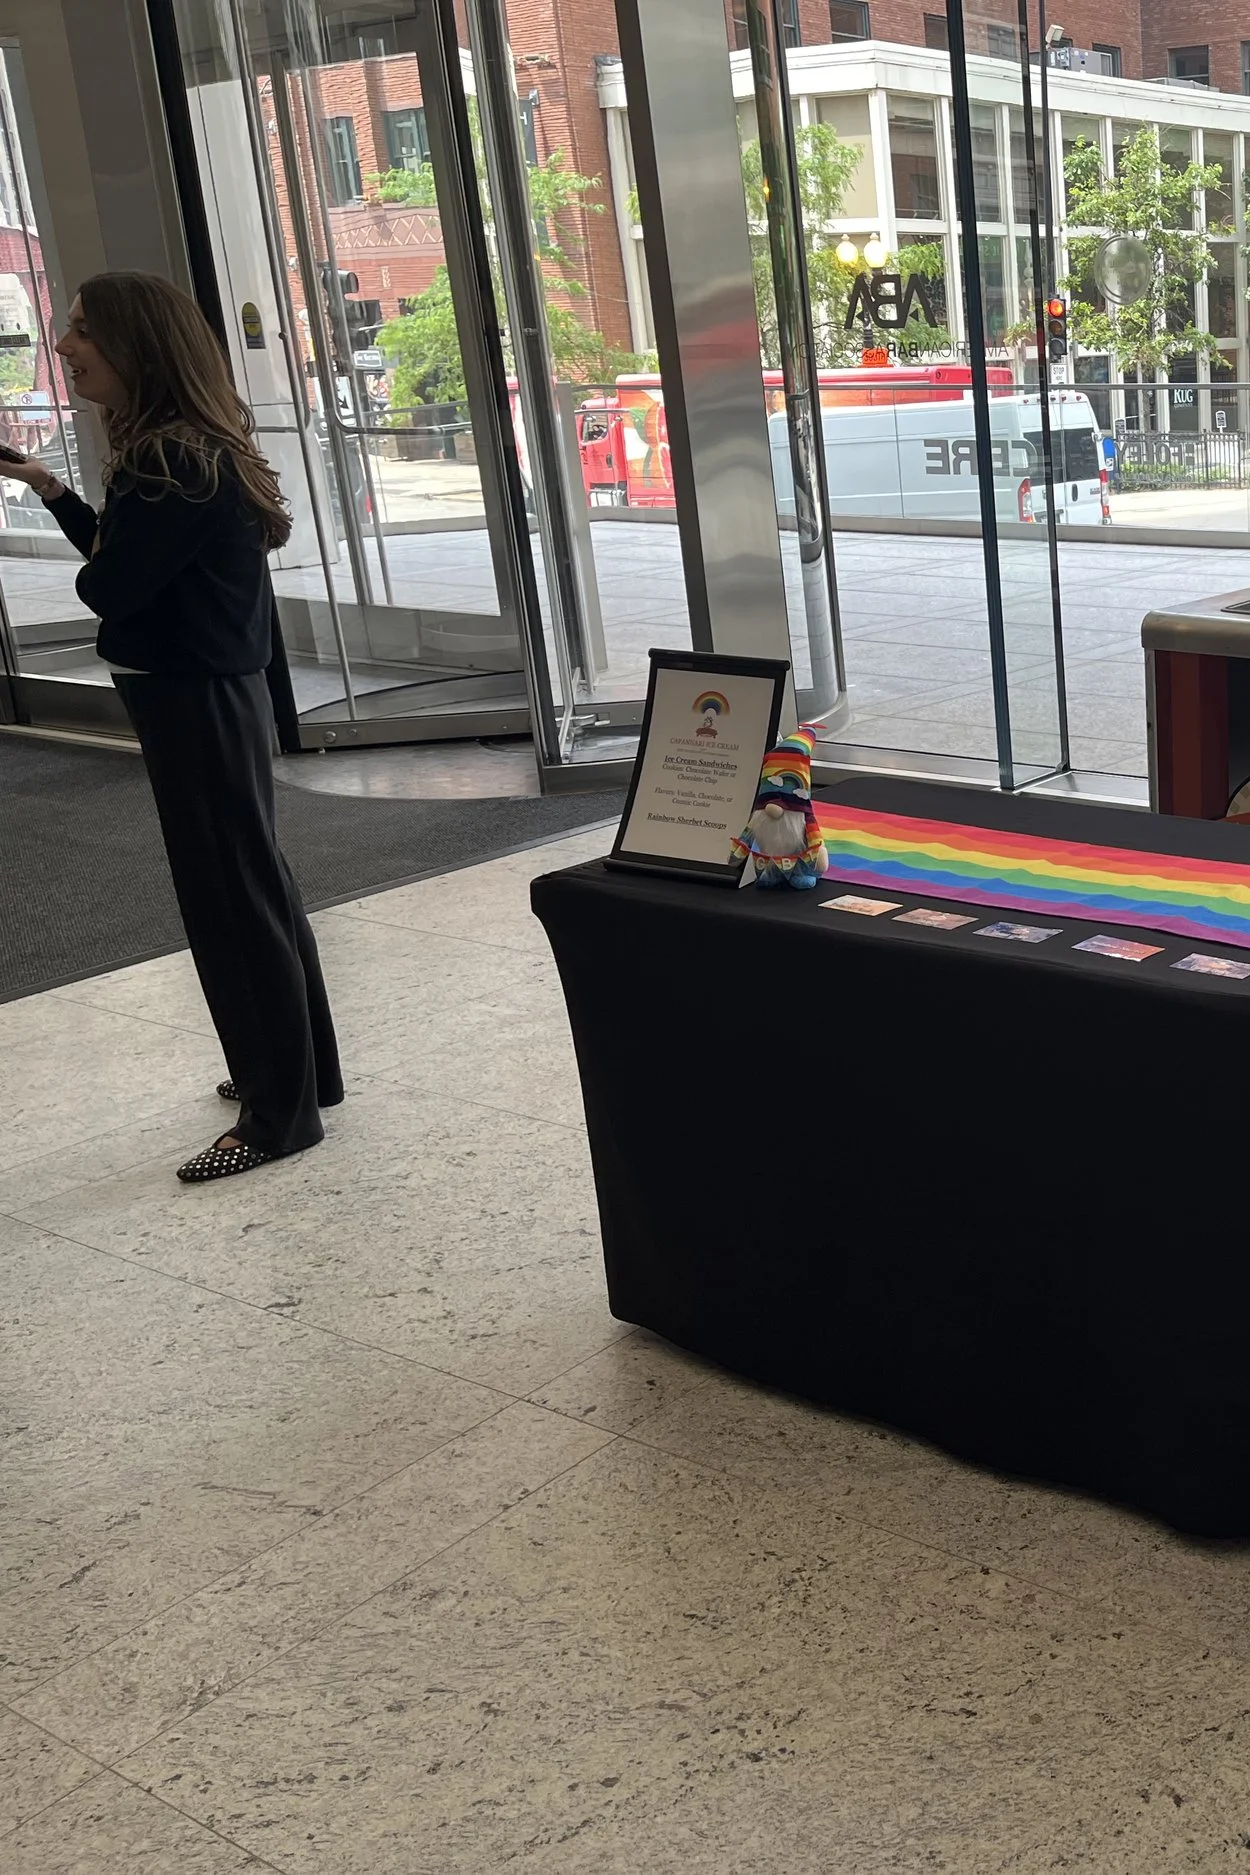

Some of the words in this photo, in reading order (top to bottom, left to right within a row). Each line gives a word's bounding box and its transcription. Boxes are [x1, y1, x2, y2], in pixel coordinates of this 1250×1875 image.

[675, 756, 698, 766] Cream
[698, 759, 738, 771] Sandwiches
[647, 812, 677, 823] Rainbow
[677, 816, 703, 827] Sherbet
[703, 820, 727, 831] Scoops
